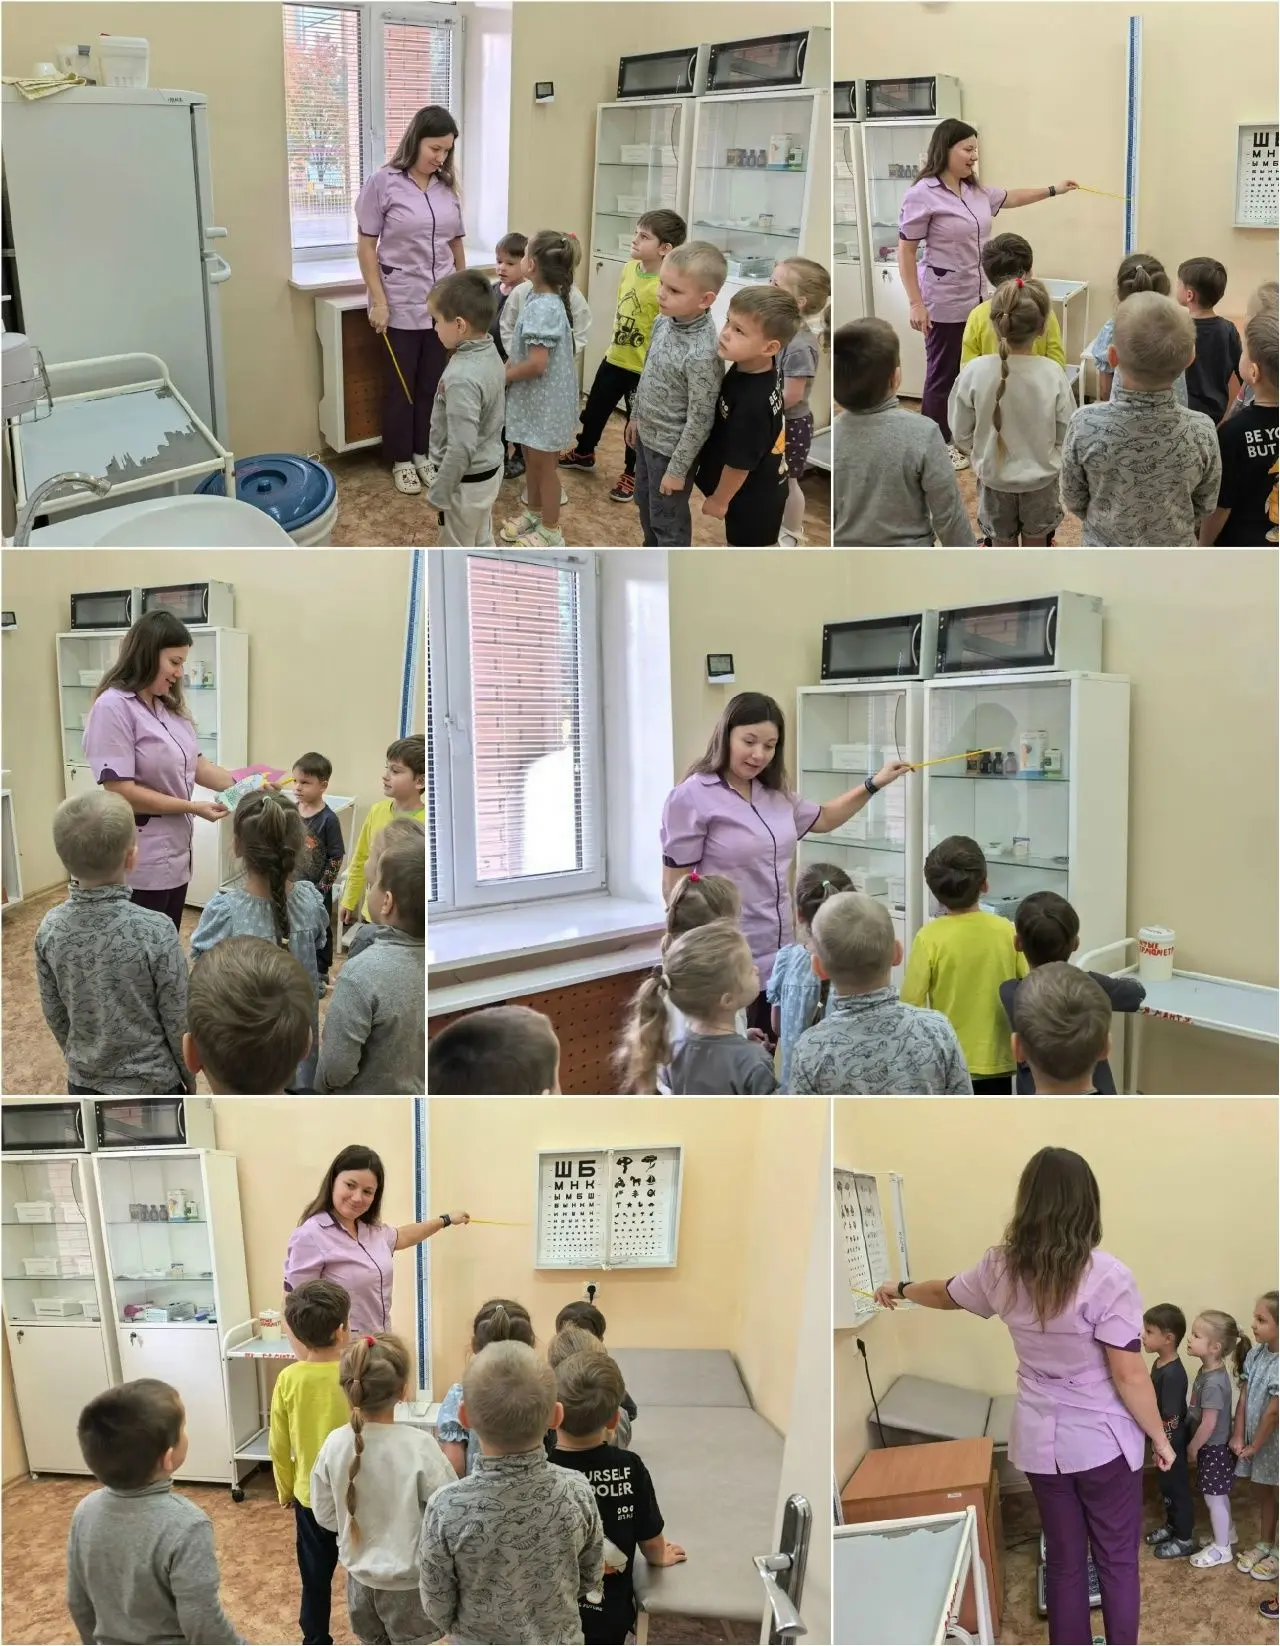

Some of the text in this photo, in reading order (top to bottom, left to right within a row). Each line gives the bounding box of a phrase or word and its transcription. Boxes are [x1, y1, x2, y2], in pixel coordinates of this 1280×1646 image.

[1245, 430, 1263, 444] BE
[1247, 443, 1277, 458] BUT
[555, 1160, 596, 1178] ШБ
